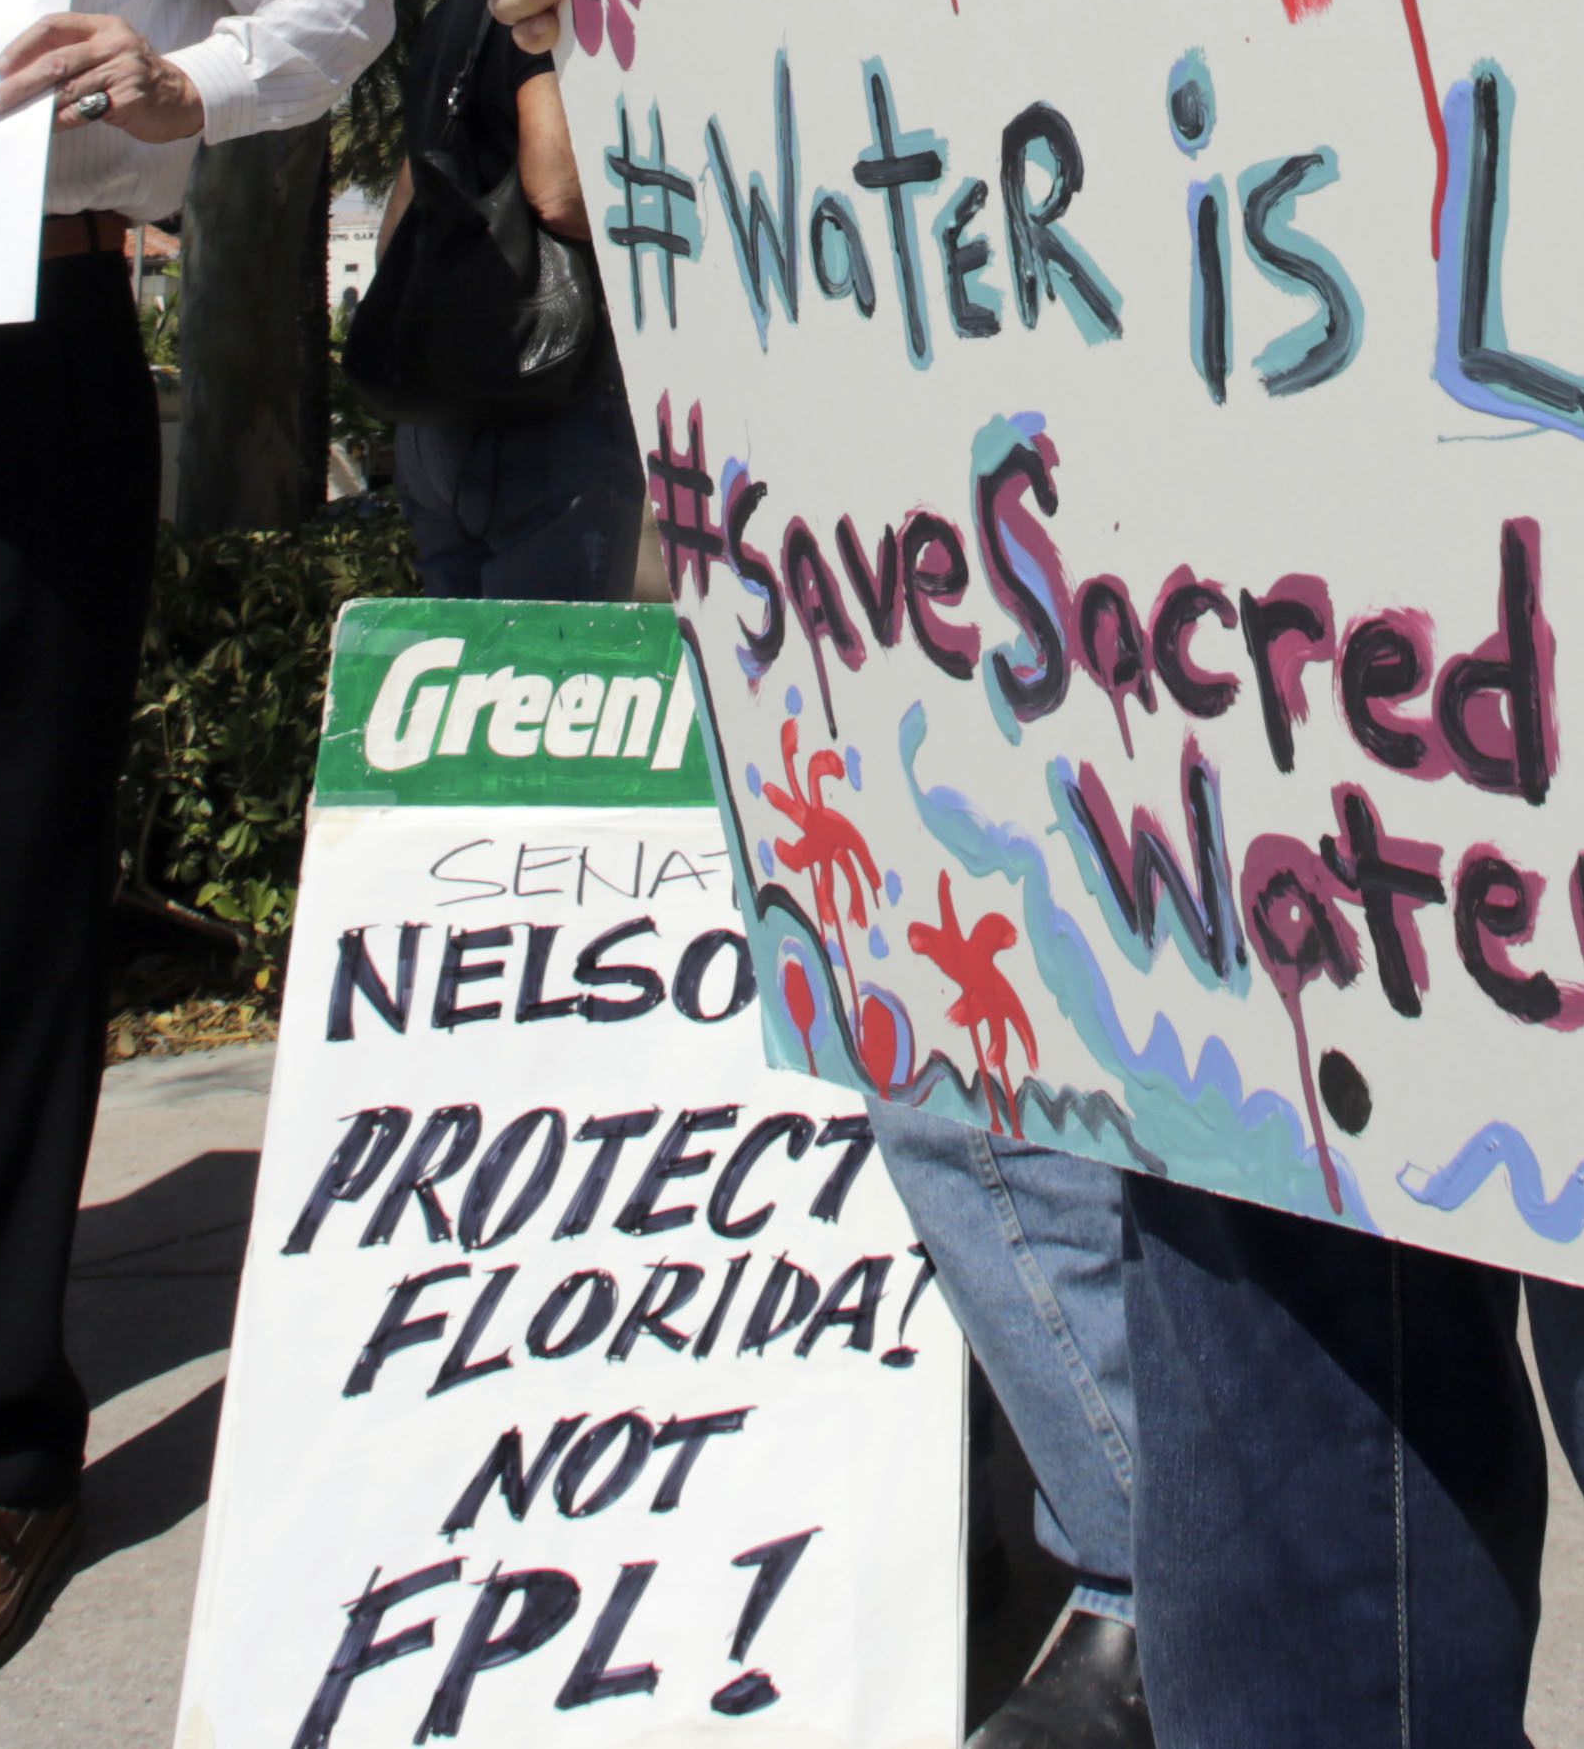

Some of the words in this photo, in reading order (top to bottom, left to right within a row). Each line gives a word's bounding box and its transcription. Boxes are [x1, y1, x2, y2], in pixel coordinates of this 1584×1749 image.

[1167, 46, 1365, 406] is
[279, 1104, 877, 1254] PROTECT
[341, 1241, 938, 1400] FLORIDA!
[437, 1404, 759, 1543] NOT
[290, 1527, 823, 1749] FPL!
